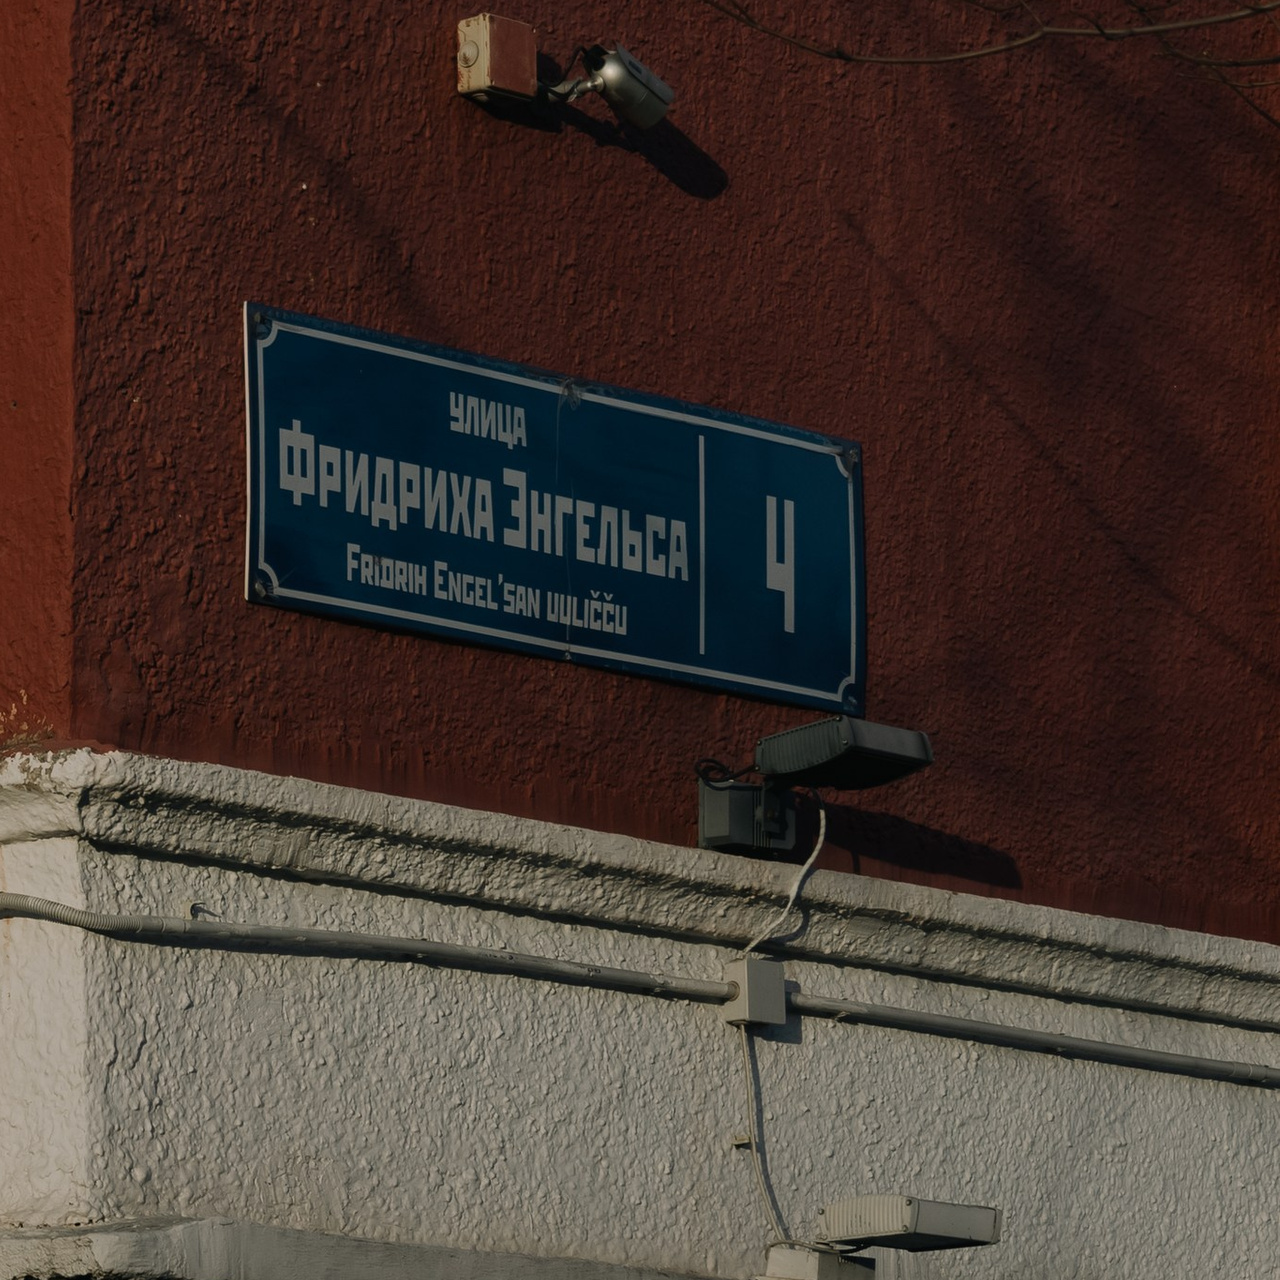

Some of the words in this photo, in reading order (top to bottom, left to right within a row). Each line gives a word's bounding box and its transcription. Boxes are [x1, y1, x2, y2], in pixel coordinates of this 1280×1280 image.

[279, 419, 495, 542] ФРИДРИХА
[503, 467, 689, 581] ЭНГЕЛЬСА
[766, 495, 795, 633] 4
